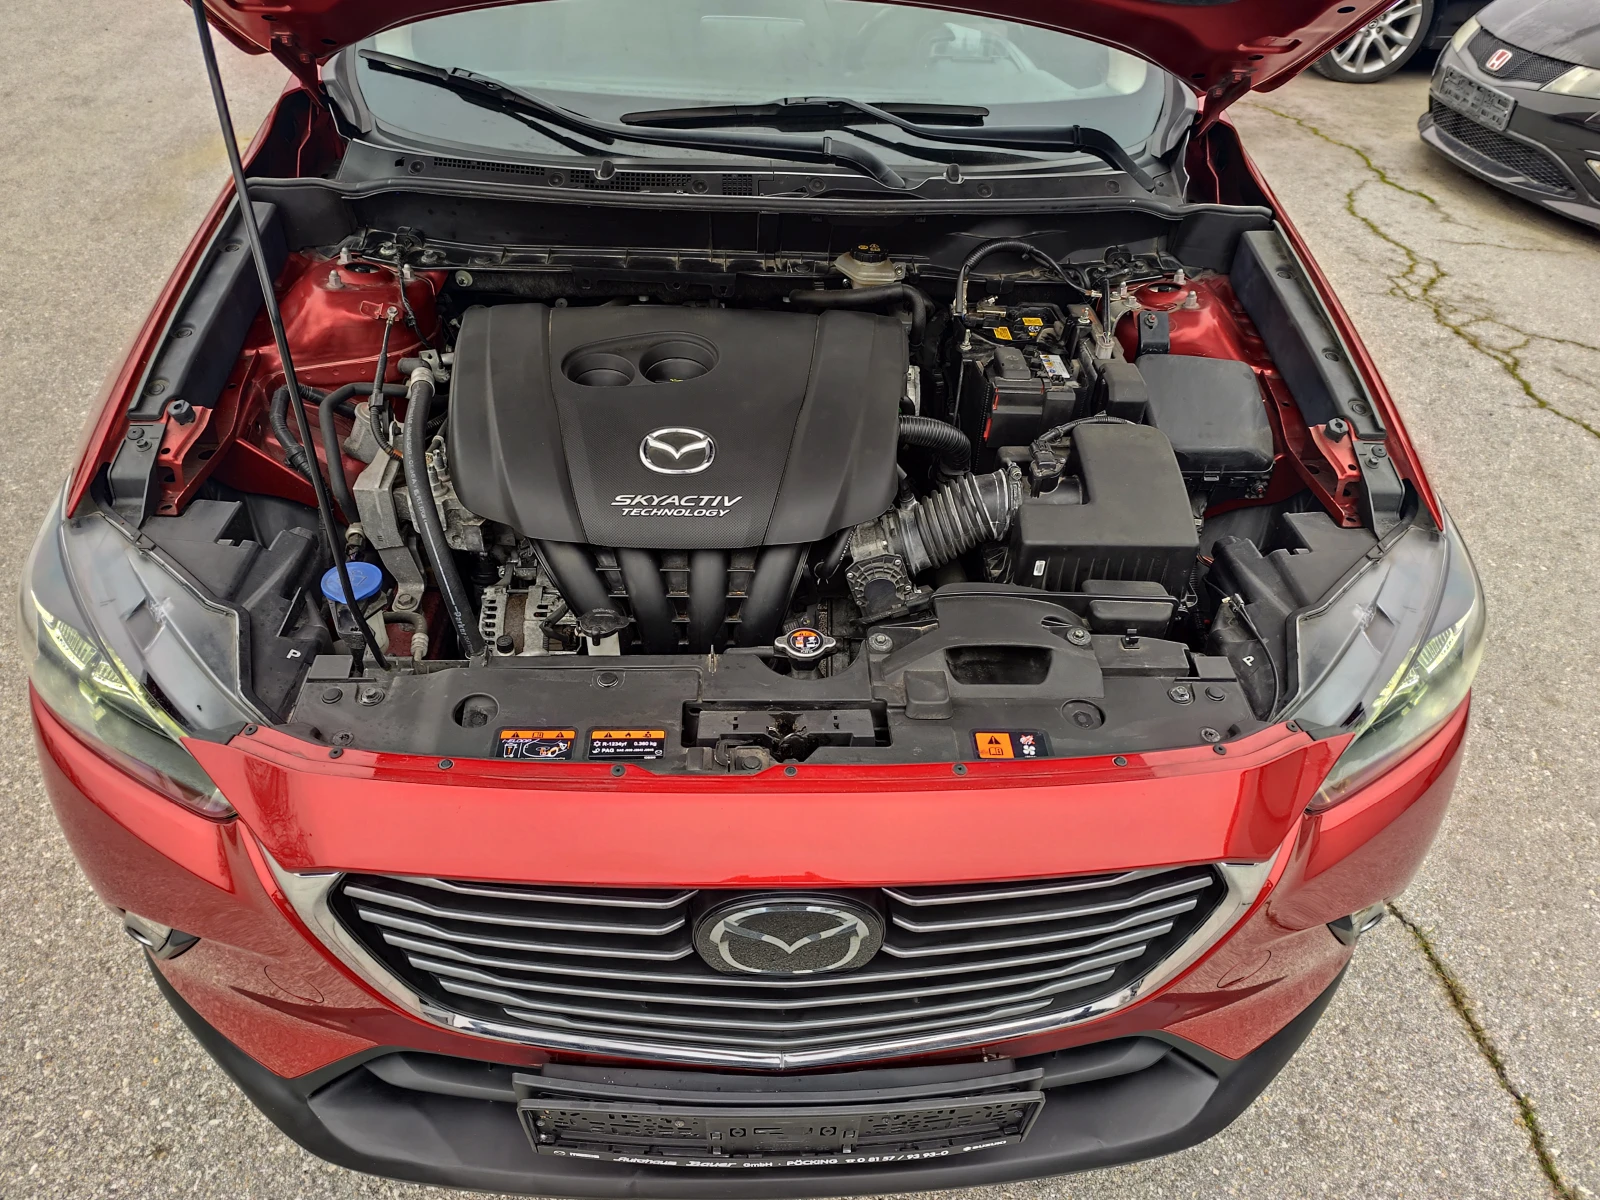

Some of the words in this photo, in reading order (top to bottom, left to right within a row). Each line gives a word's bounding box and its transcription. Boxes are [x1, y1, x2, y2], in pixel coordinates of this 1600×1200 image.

[611, 494, 742, 507] SKYACTIV
[622, 508, 730, 517] TECHNOLOGY
[286, 649, 301, 659] P
[1242, 655, 1255, 667] P
[786, 1158, 838, 1167] PÖCKING
[923, 1150, 949, 1159] 93-0
